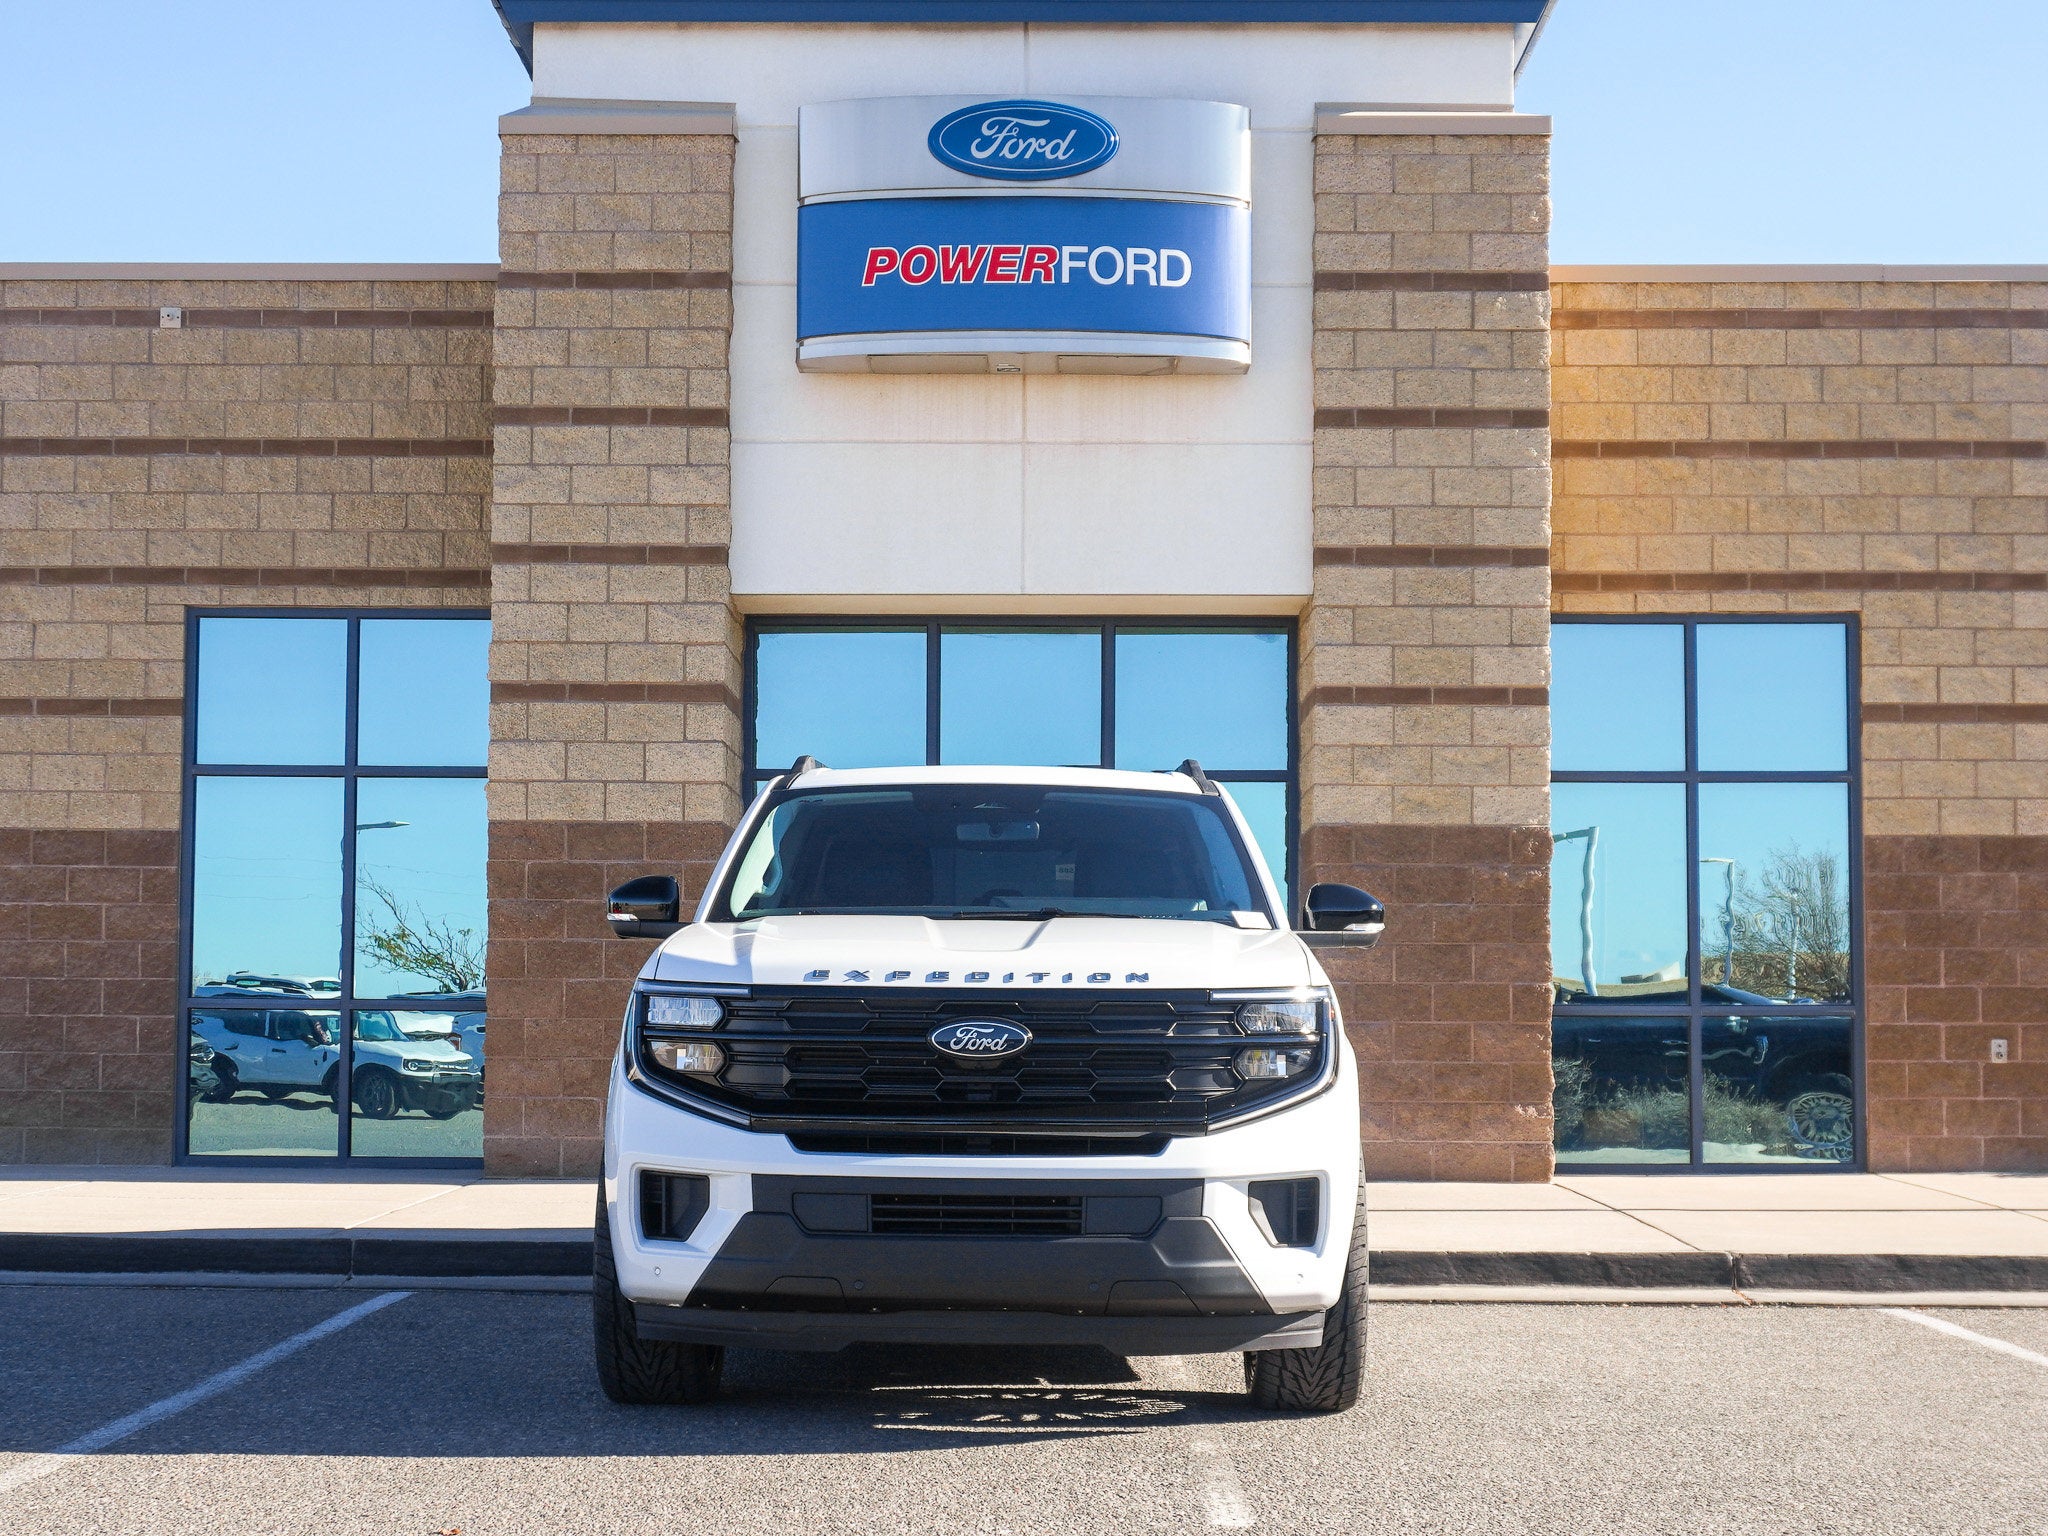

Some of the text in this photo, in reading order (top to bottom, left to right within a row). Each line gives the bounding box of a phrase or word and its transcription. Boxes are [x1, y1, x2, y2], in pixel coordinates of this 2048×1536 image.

[970, 116, 1075, 160] Ford
[803, 969, 1150, 984] EXPEDITION
[950, 1026, 1007, 1051] Ford
